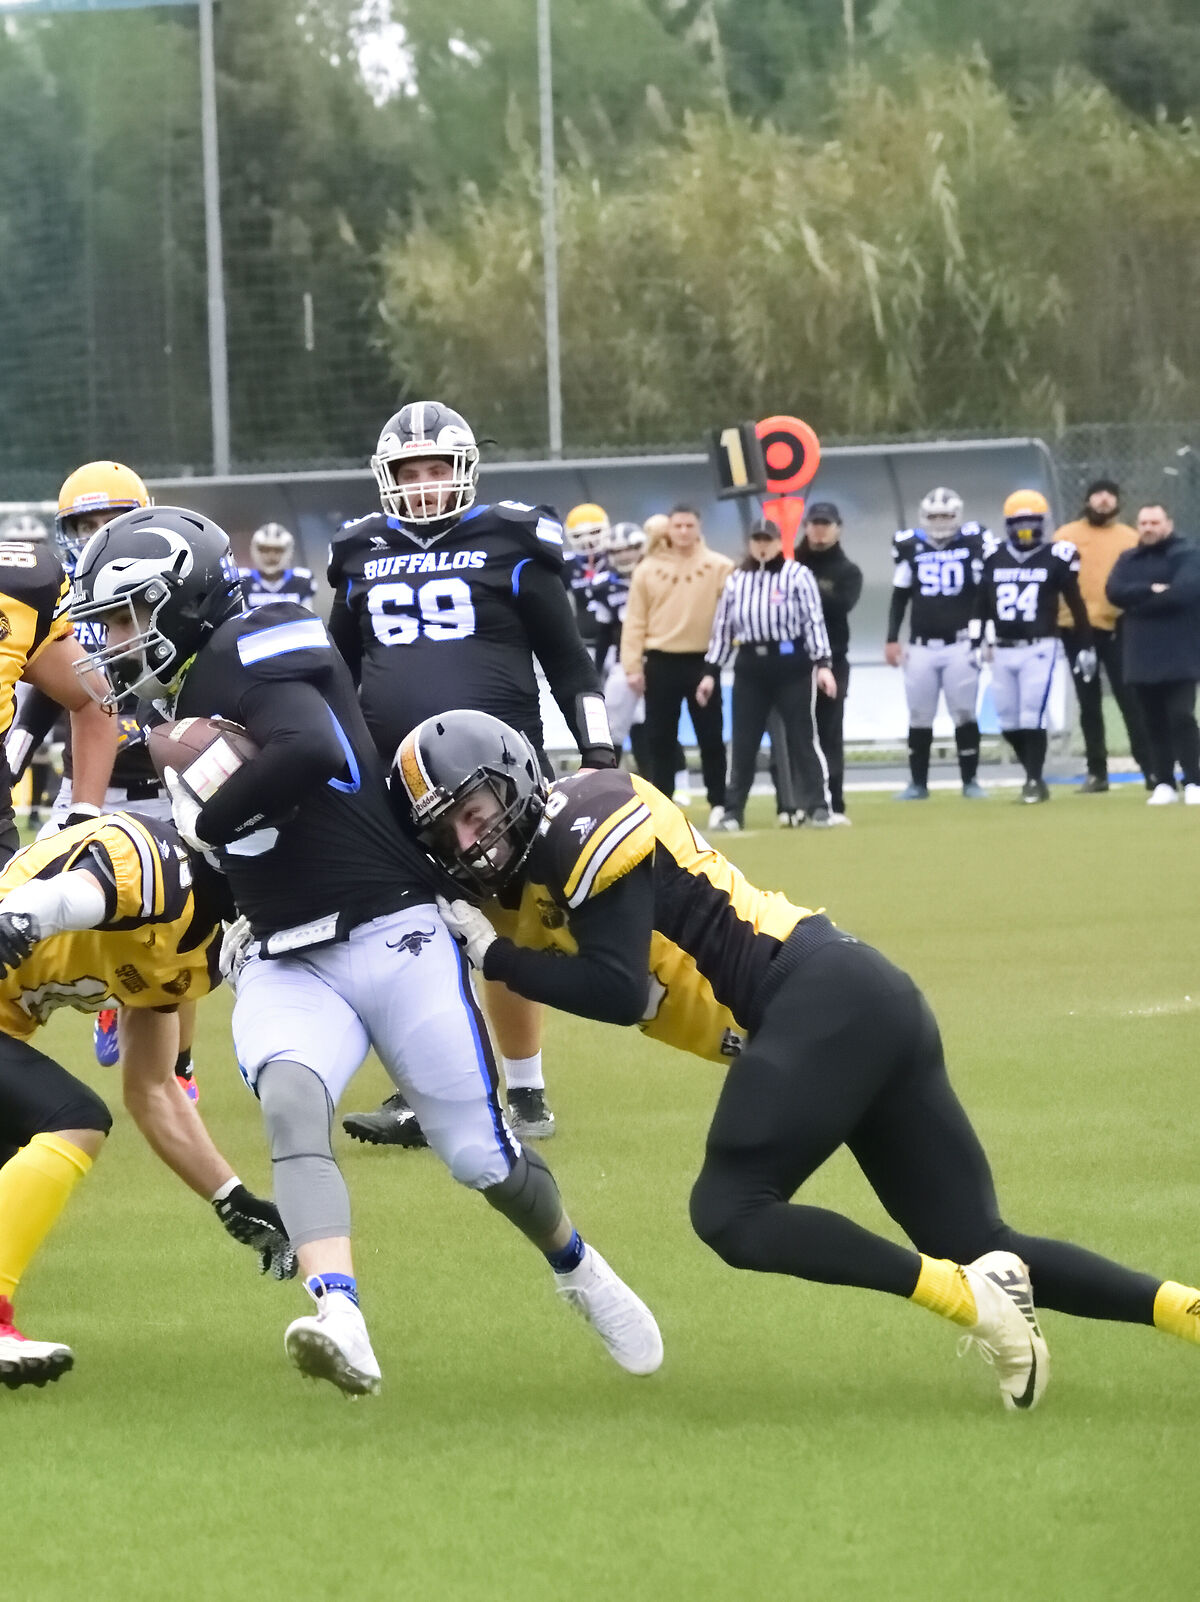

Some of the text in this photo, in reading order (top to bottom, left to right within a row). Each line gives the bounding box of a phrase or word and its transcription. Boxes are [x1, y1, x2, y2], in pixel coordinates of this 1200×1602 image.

[719, 427, 749, 488] 1
[362, 550, 488, 580] BUFFALOS
[917, 560, 965, 597] 50
[367, 577, 476, 647] 69
[995, 582, 1040, 632] 24
